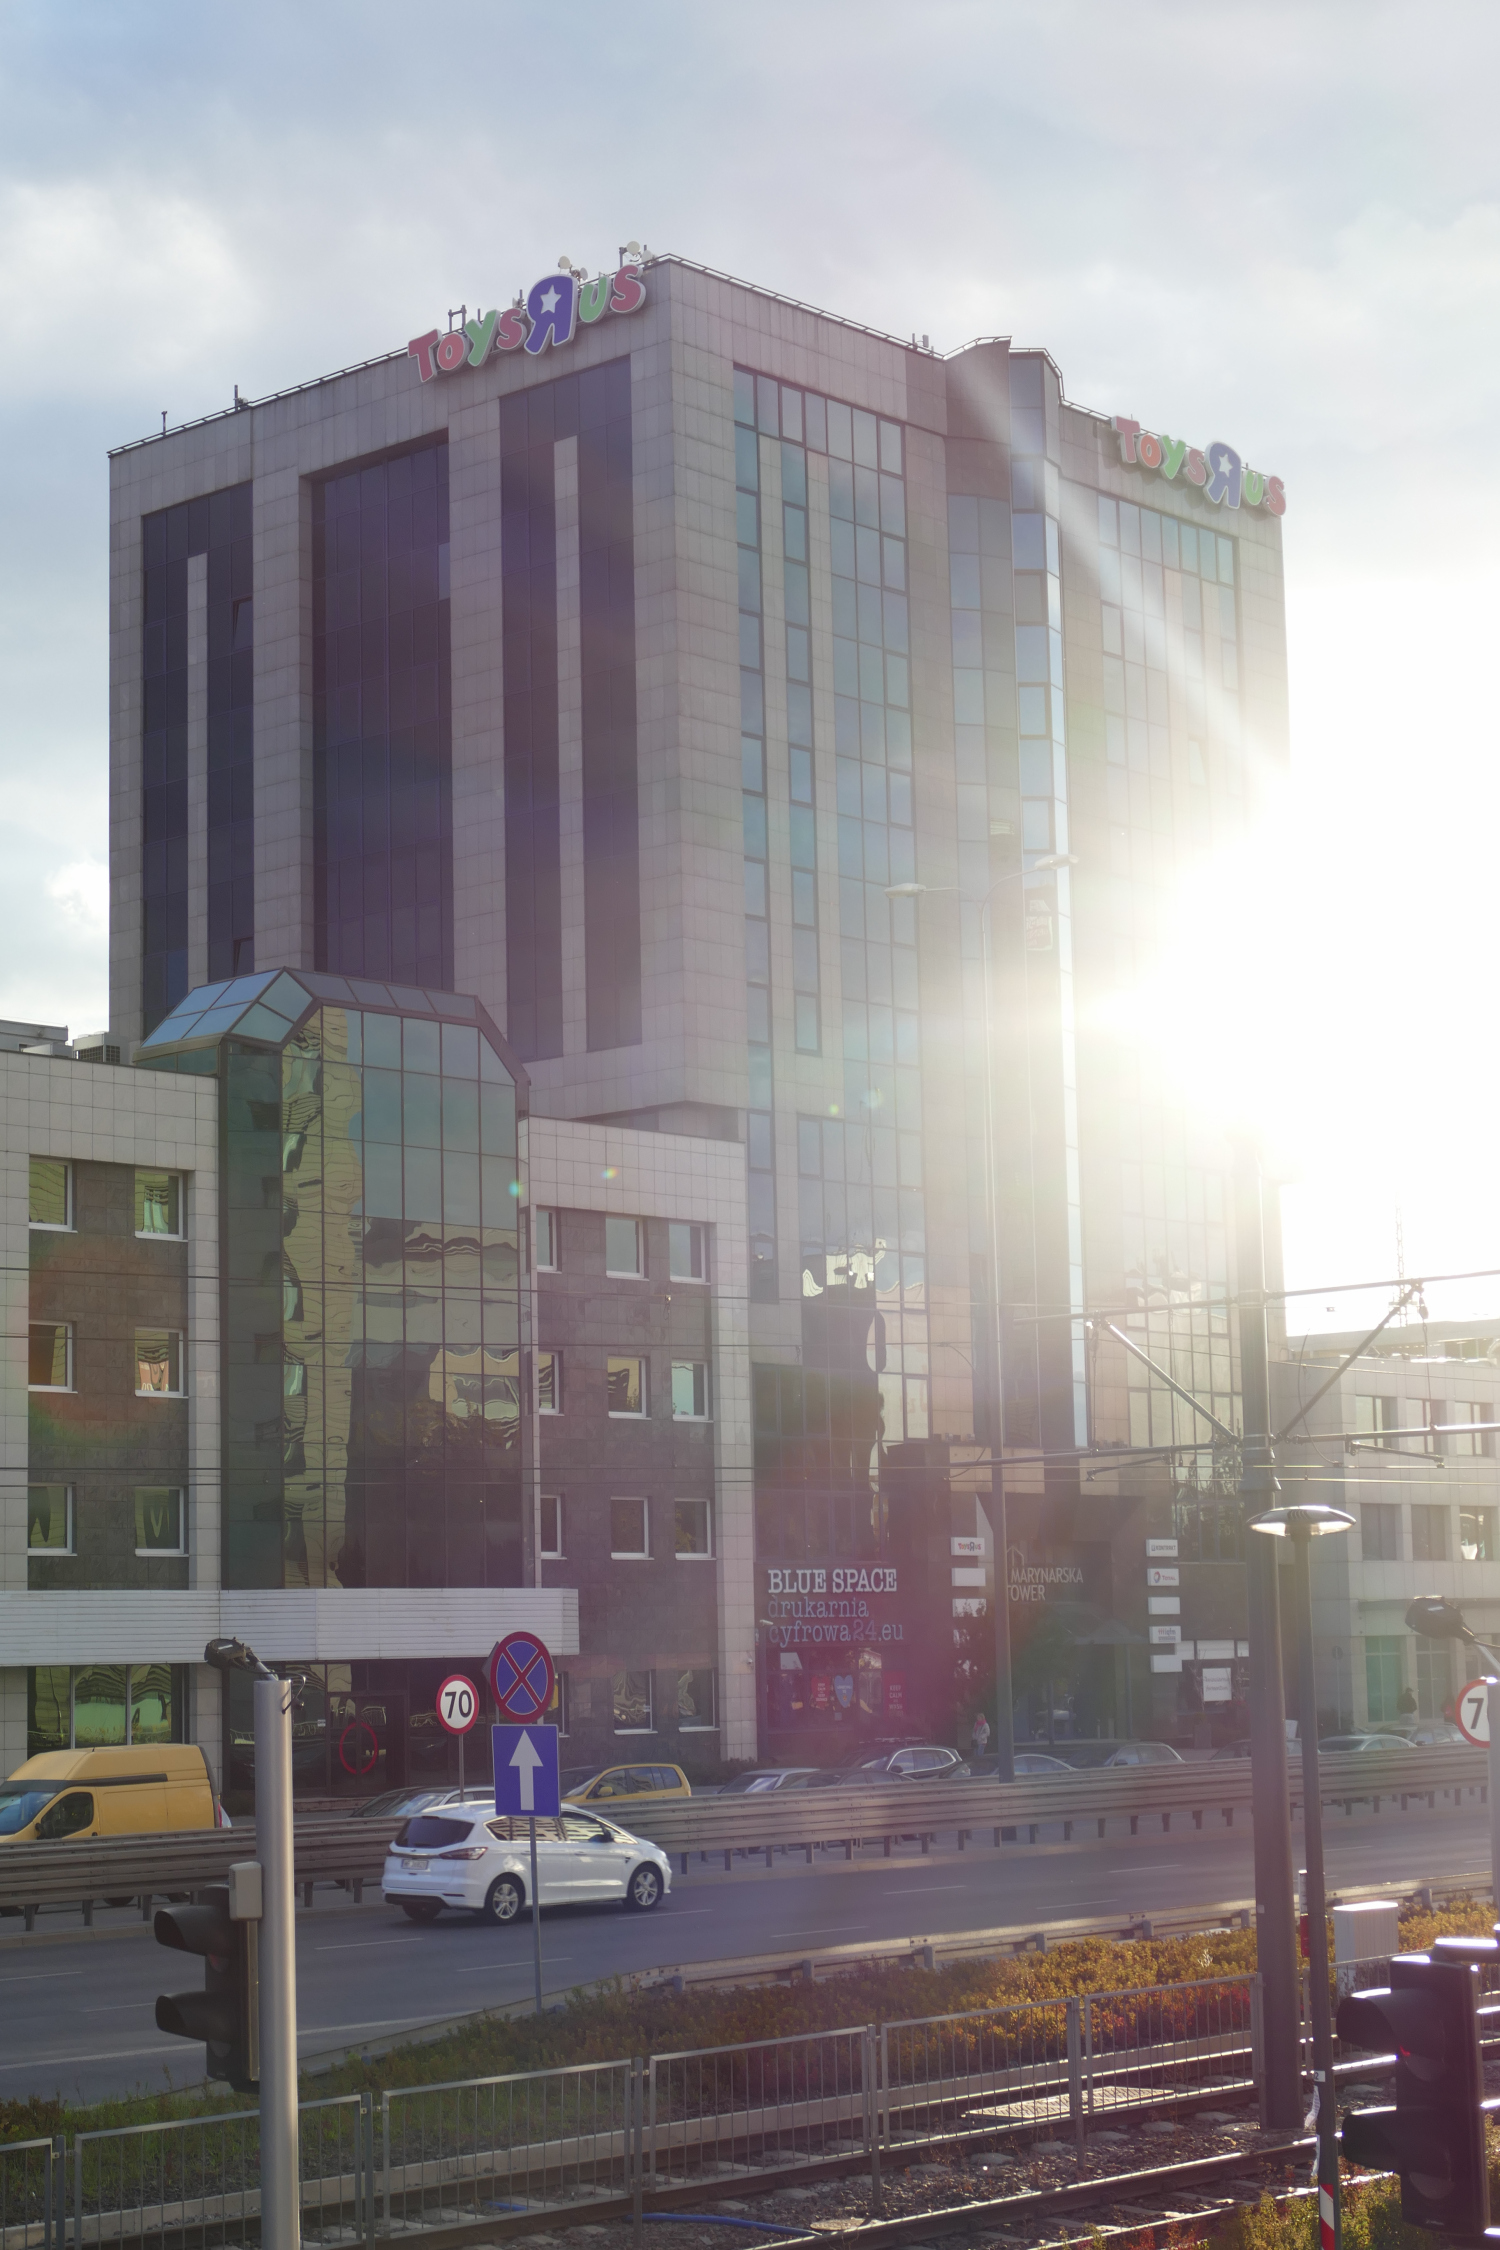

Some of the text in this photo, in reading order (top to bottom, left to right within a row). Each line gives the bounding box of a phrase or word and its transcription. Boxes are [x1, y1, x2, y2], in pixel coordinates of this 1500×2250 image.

[767, 1568, 898, 1593] BLUE SPACE
[1010, 1567, 1084, 1583] MARYNARSKA
[768, 1595, 870, 1618] drukarnia
[768, 1618, 904, 1648] cyfrowa24.eu
[444, 1689, 473, 1719] 70
[1467, 1697, 1489, 1730] 7
